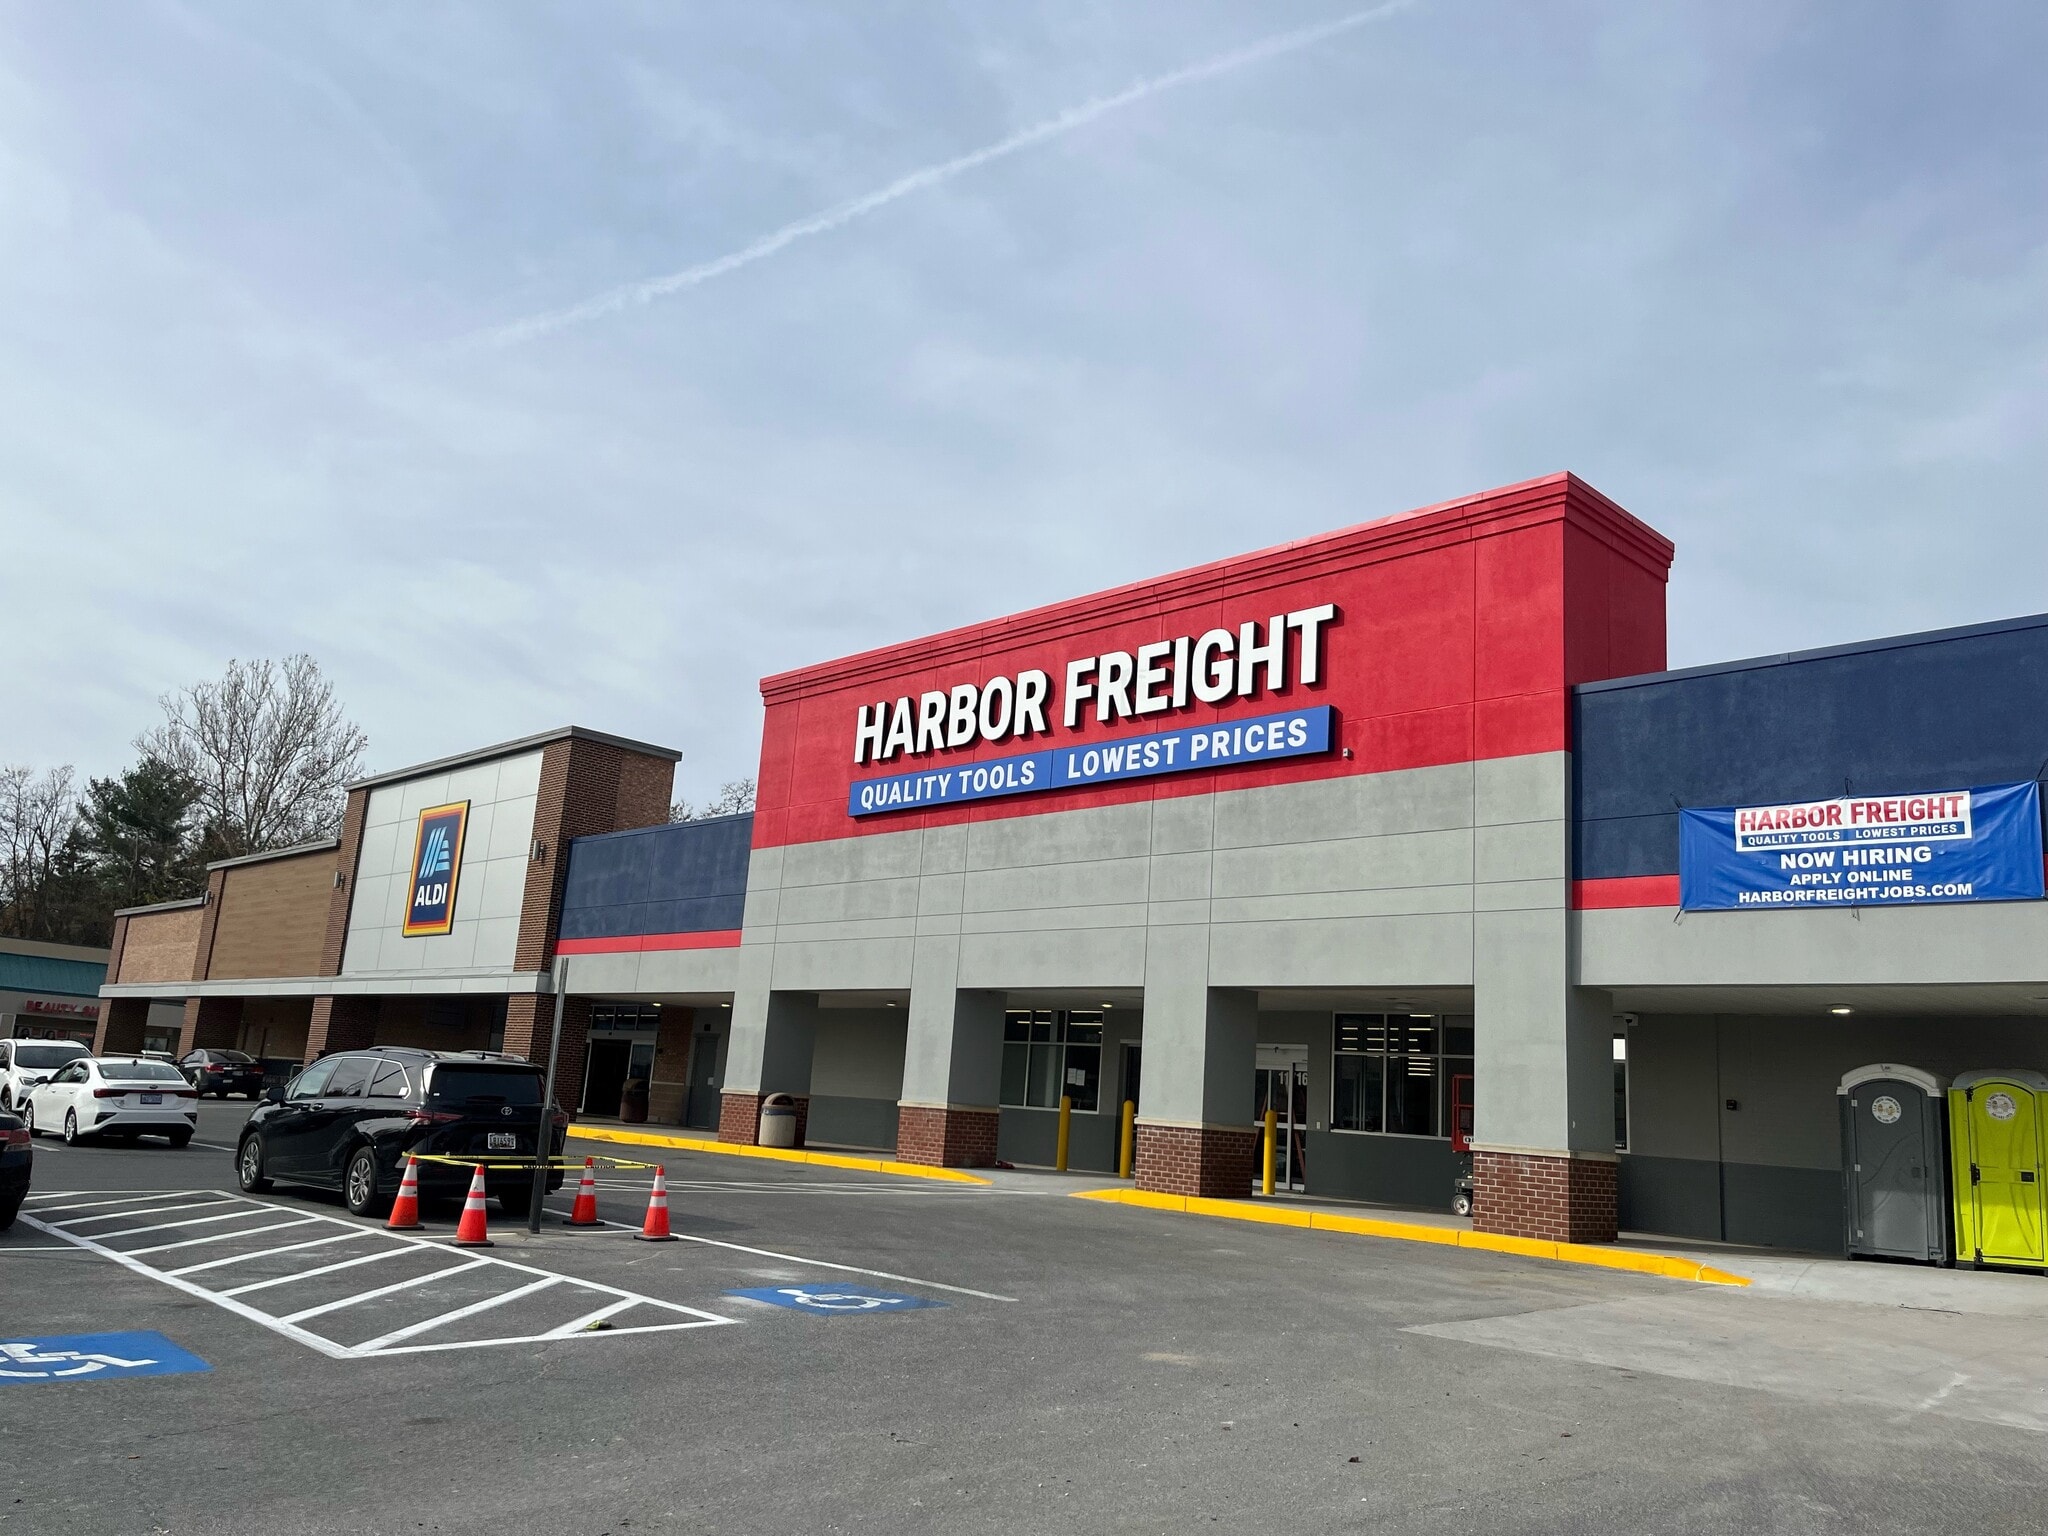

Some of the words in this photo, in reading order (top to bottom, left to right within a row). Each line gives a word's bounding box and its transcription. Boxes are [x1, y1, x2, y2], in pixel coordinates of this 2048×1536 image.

[854, 669, 1048, 764] HARBOR
[1063, 603, 1335, 727] FREIGHT
[860, 773, 952, 810] QUALITY
[958, 760, 1036, 795] TOOLS
[1067, 737, 1180, 779] LOWEST
[1190, 718, 1308, 761] PRICES
[1740, 804, 1843, 832] HARBOR
[1850, 795, 1964, 825] FREIGHT
[1748, 834, 1798, 846] QUALITY
[1801, 831, 1841, 842] TOOLS
[1855, 827, 1906, 839] LOWEST
[1910, 824, 1957, 836] PRICES
[1780, 851, 1835, 870] NOW
[1842, 846, 1932, 866] HIRING
[1789, 872, 1842, 886] APPLY
[1847, 868, 1913, 883] ONLINE
[414, 883, 448, 907] ALDI
[1739, 883, 1972, 903] HARBORFREIGHTJOBS.COM
[26, 1000, 78, 1013] BEAUTY
